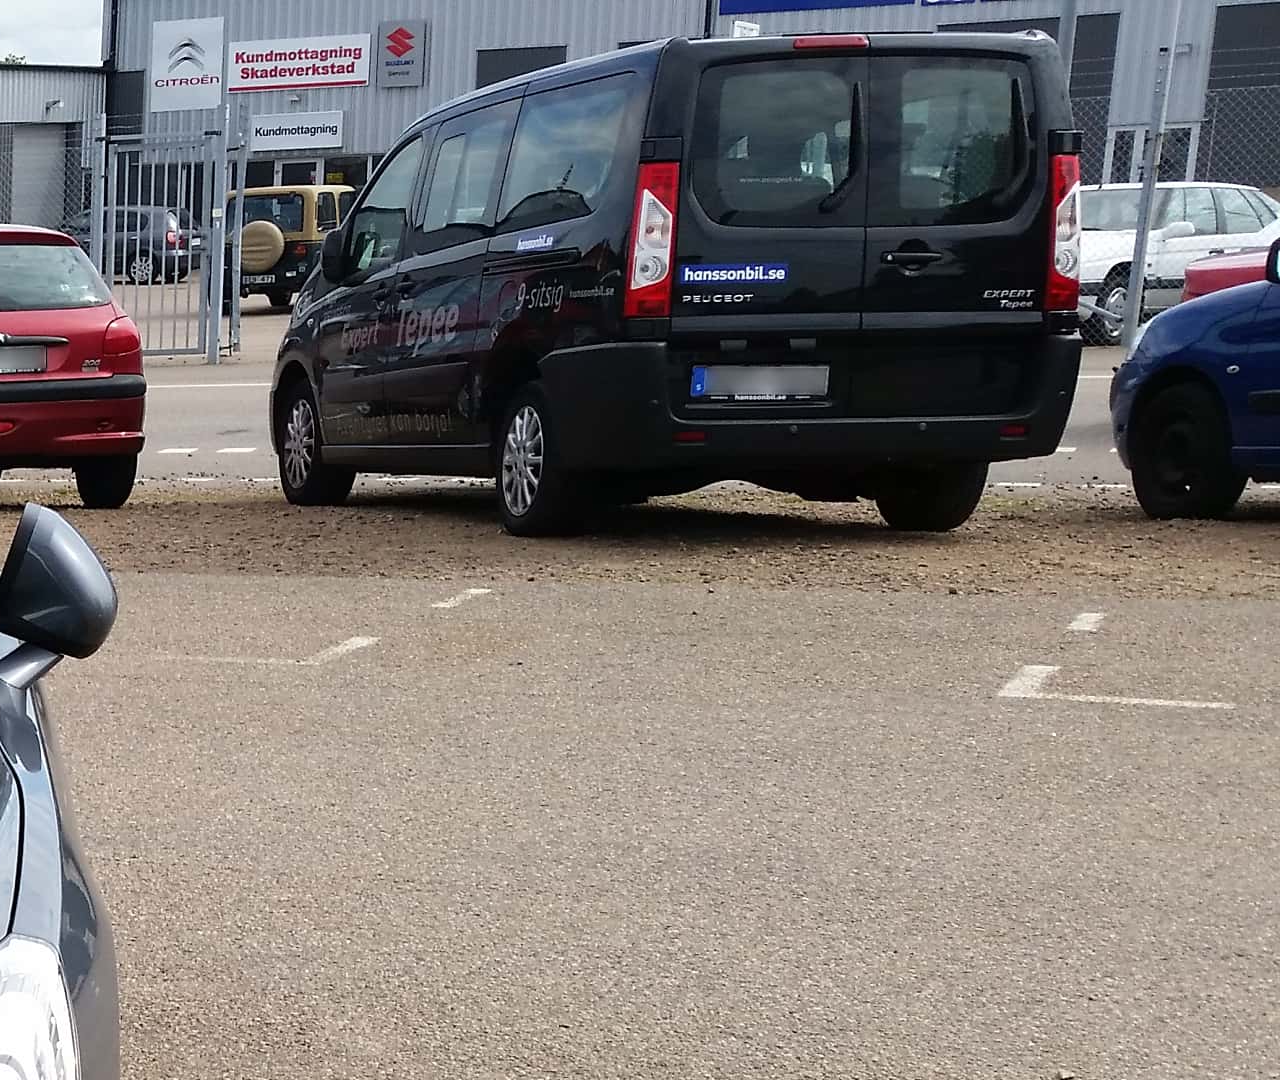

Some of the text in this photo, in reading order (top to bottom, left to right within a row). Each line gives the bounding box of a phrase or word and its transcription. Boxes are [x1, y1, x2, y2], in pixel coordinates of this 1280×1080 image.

[235, 45, 362, 64] Kundmottagning
[240, 62, 355, 80] Skadeverkstad
[155, 74, 220, 88] CITROËN
[254, 123, 338, 138] Kundmottagning
[684, 266, 786, 282] hanssonbil.se
[515, 278, 565, 313] 9-sitsig
[682, 294, 755, 303] PEUGEOT
[983, 289, 1036, 298] EXPERT
[1000, 300, 1034, 309] Tepee
